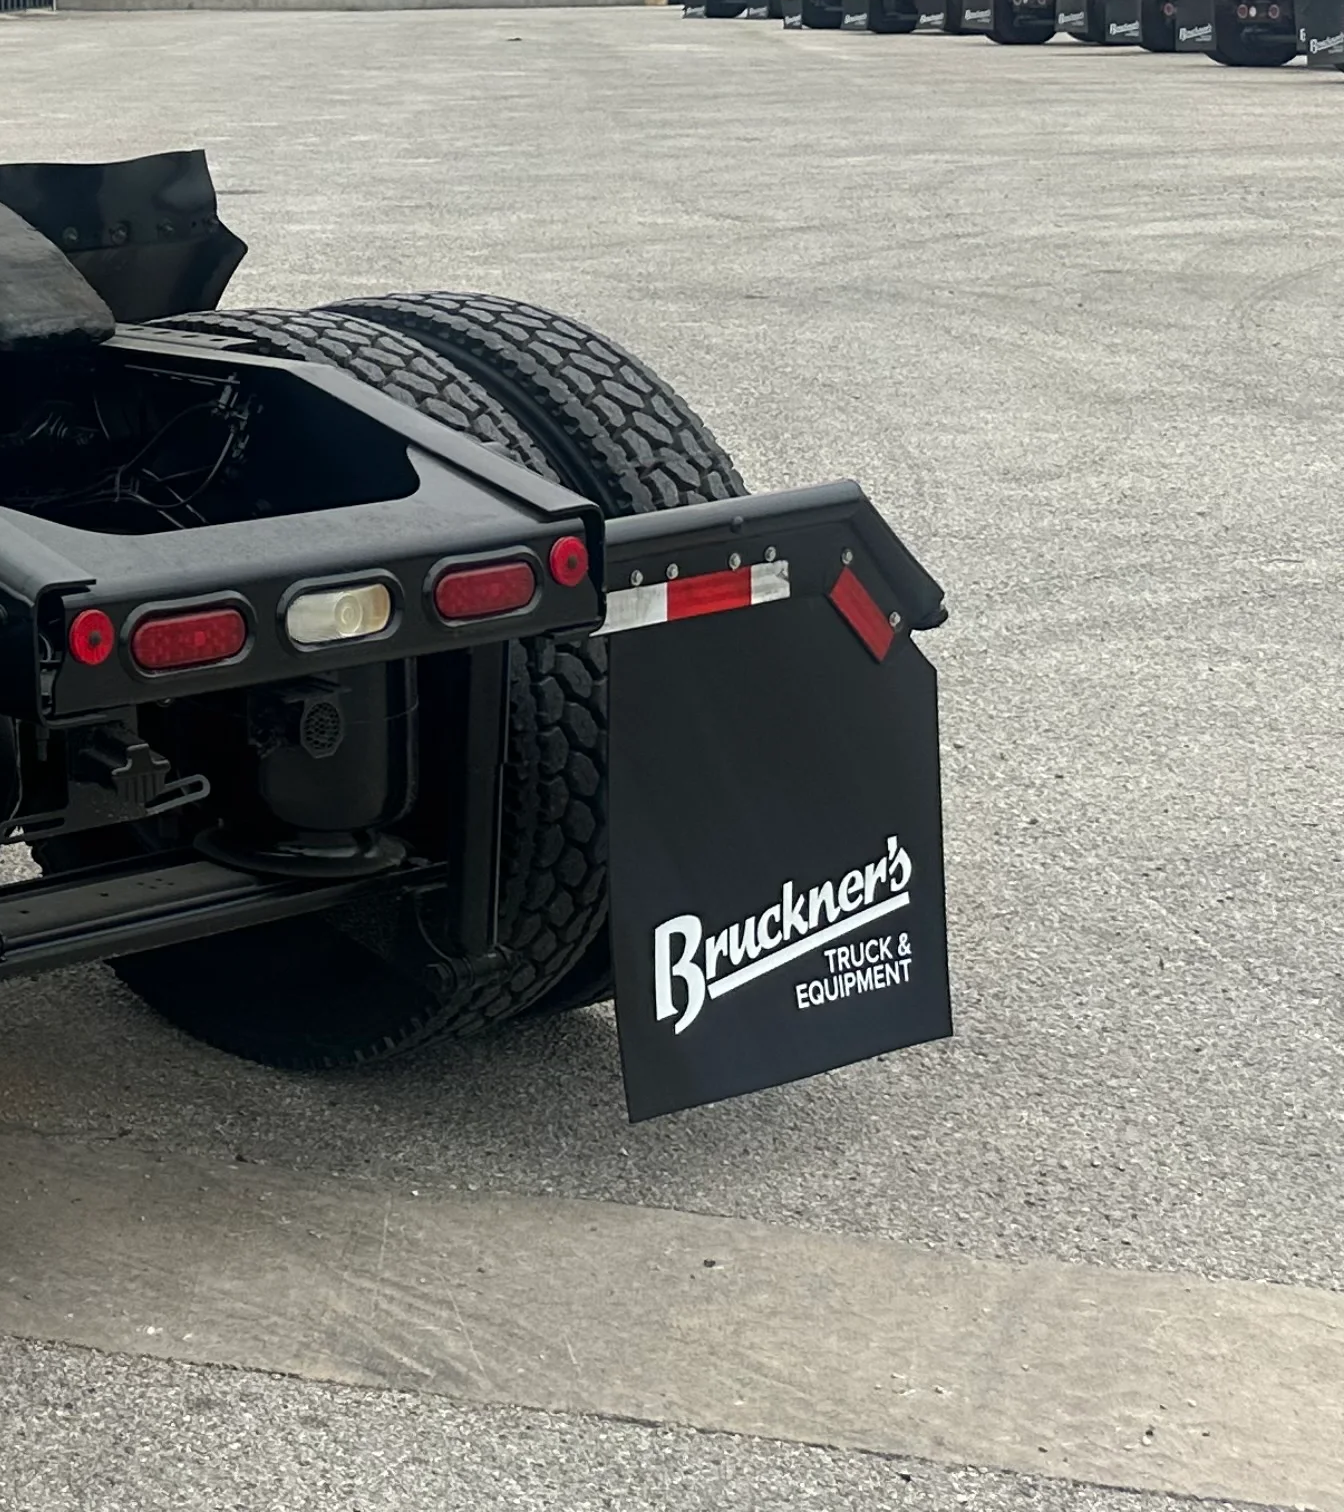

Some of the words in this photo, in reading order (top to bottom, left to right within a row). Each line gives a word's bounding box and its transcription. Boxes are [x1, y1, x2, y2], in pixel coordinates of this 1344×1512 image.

[654, 835, 913, 1035] Bruckner's
[825, 936, 893, 974] TRUCK
[898, 933, 912, 955] &
[796, 958, 912, 1009] EQUIPMENT
